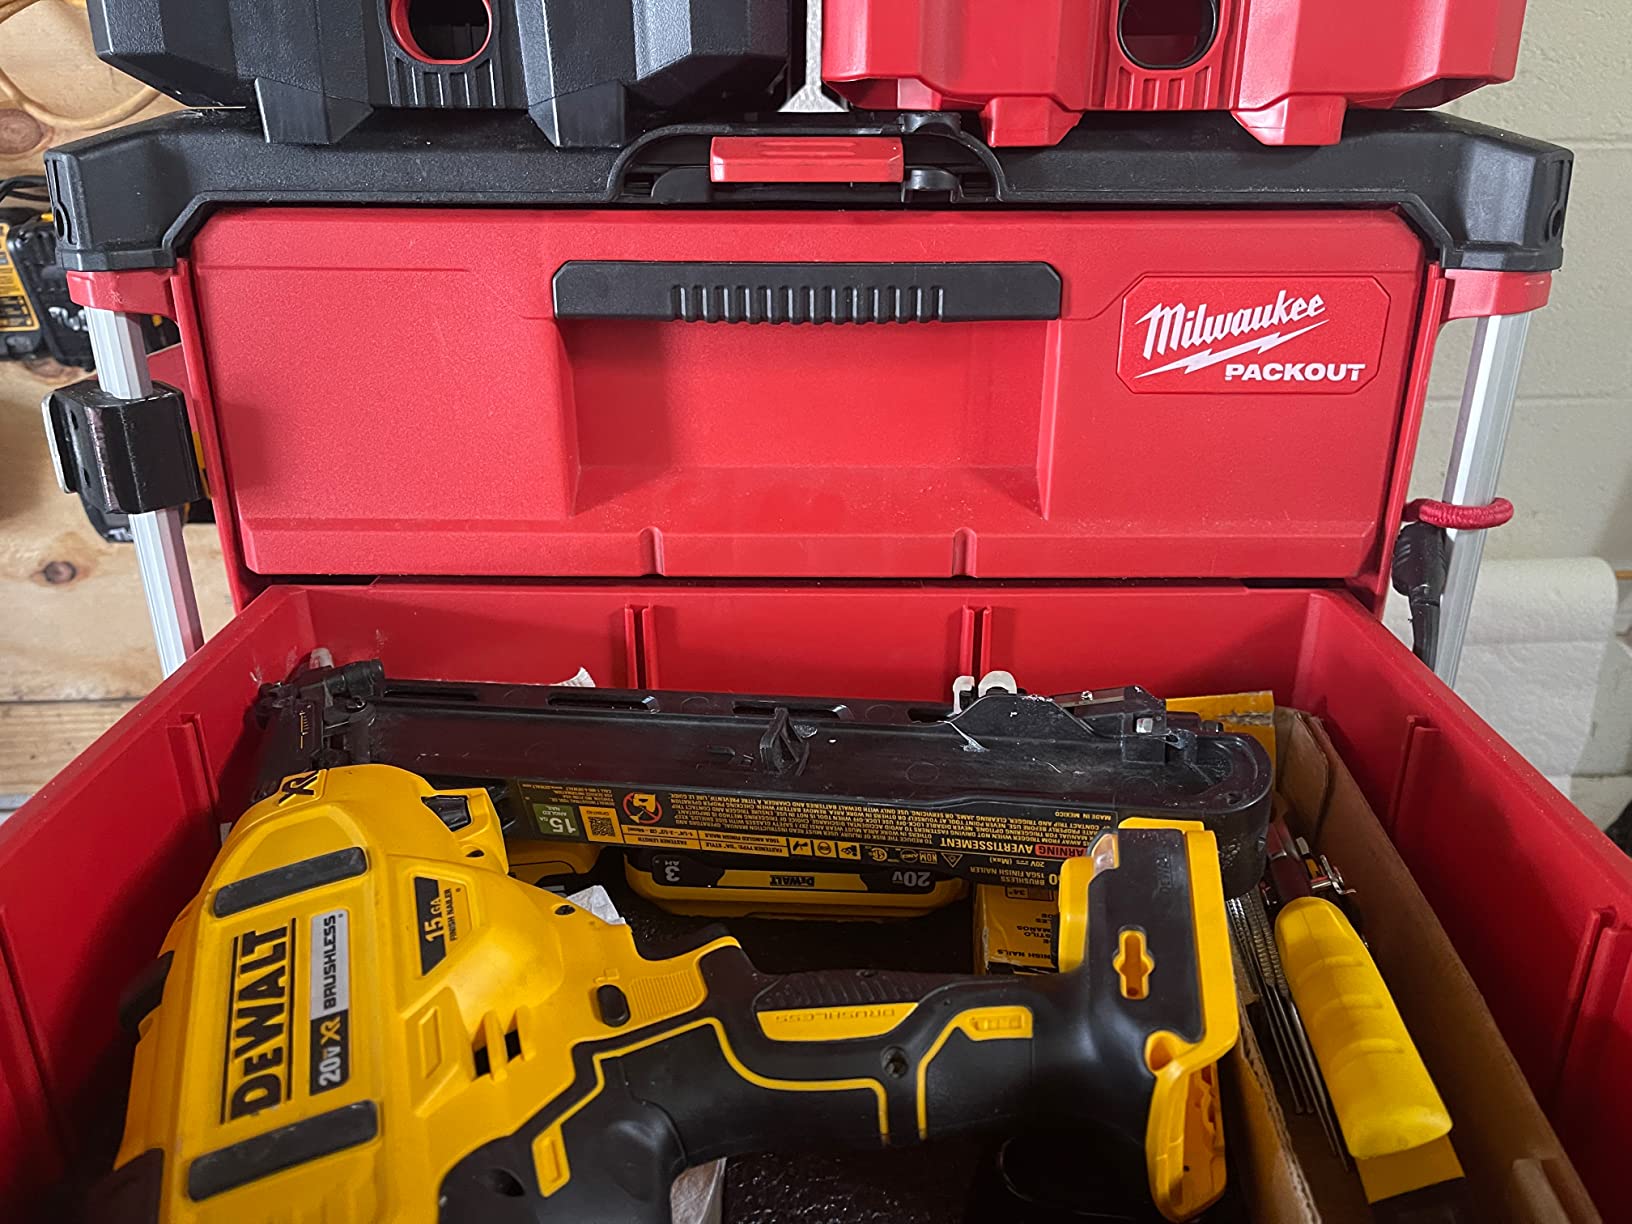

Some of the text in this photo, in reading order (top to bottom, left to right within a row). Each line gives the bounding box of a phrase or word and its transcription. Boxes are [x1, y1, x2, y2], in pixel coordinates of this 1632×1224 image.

[1135, 290, 1326, 360] Milwaukee
[1225, 363, 1365, 381] PACKOUT
[549, 816, 576, 833] 15
[939, 837, 1083, 857] ARNING AVERTISSEMENT
[989, 856, 1012, 864] (Max)
[665, 866, 680, 882] 3
[969, 866, 996, 874] NAILER
[998, 868, 1023, 876] FINISH
[769, 874, 815, 887] DEWALT
[1000, 875, 1044, 885] BRUSHLESS
[424, 896, 444, 942] 15 GA
[444, 888, 458, 941] FINISH NAILER
[997, 949, 1026, 957] NAILS
[323, 914, 336, 1010] BRUSHLESS
[229, 925, 288, 1121] DEWALT
